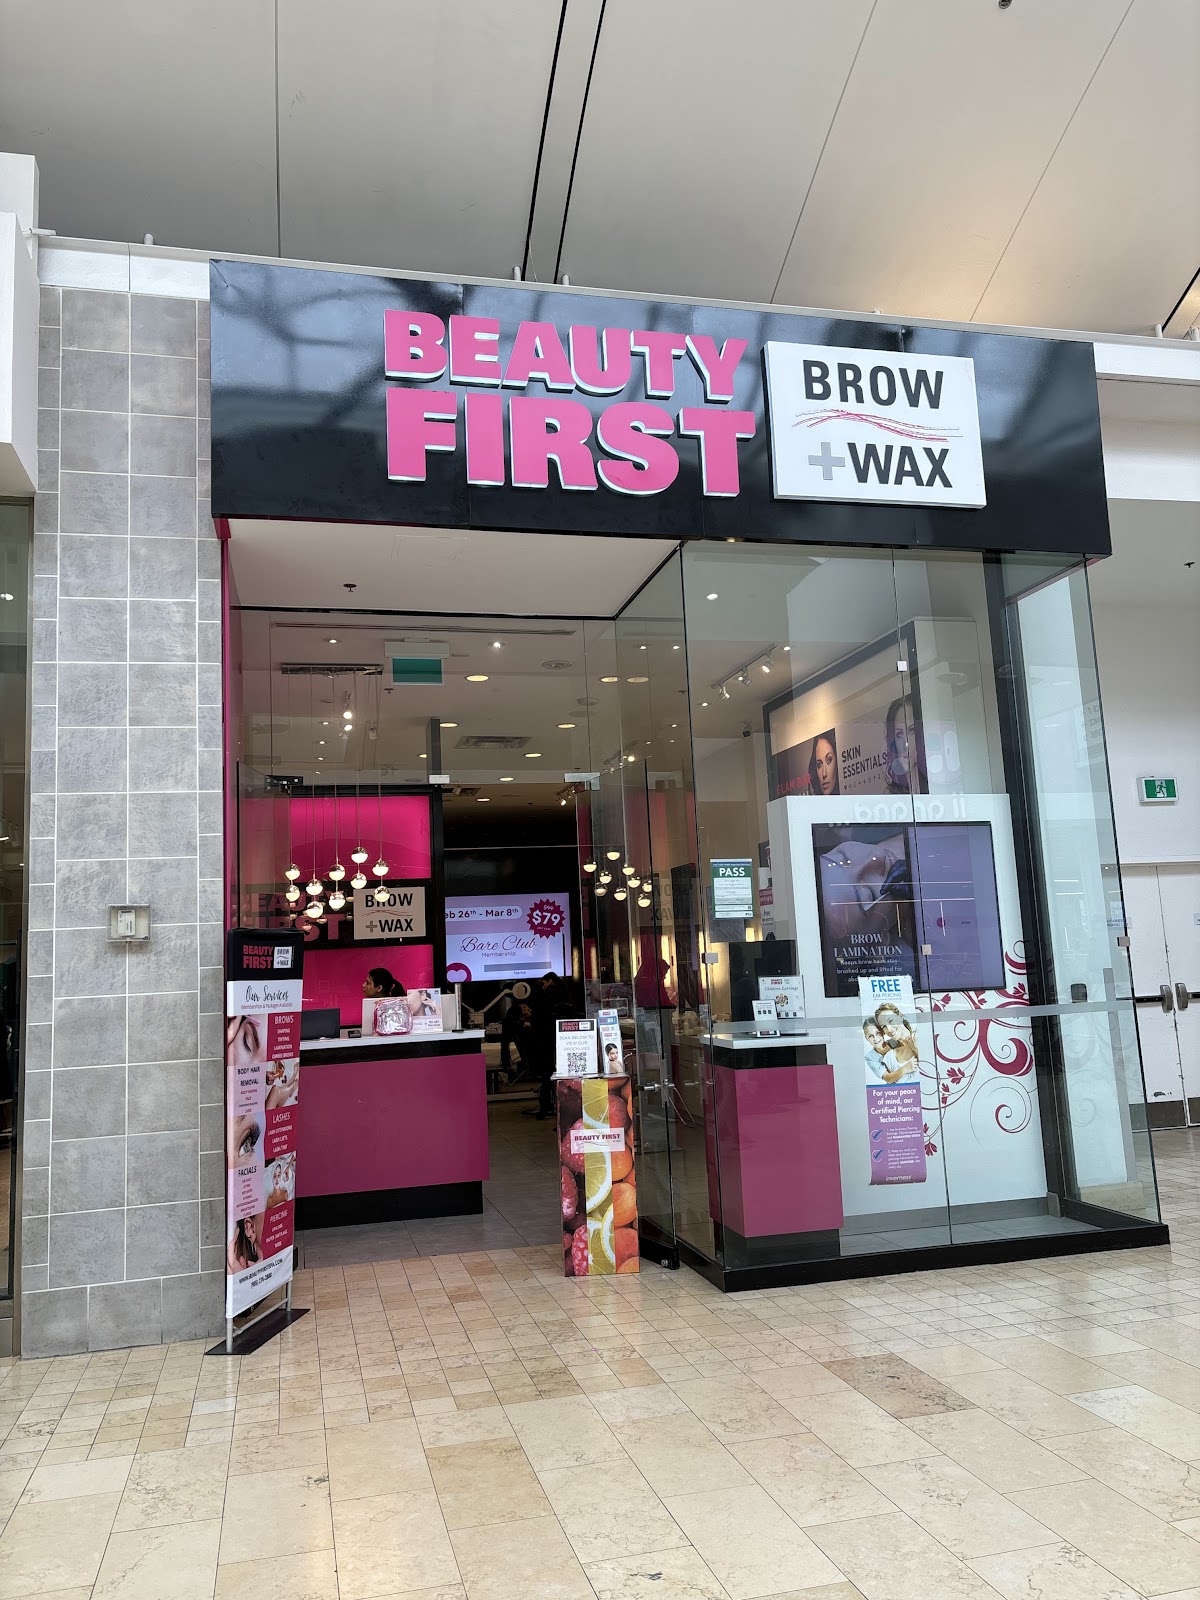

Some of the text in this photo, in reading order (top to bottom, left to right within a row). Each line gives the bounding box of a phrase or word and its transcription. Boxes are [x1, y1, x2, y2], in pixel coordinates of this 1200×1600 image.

[384, 309, 749, 401] BEAUTY
[803, 359, 944, 409] BROW
[386, 387, 756, 497] FIRST
[841, 744, 861, 763] SKIN
[843, 751, 888, 779] ESSENTIALS
[719, 867, 746, 877] PASS
[444, 910, 456, 919] eb
[458, 909, 477, 919] 26th
[485, 909, 504, 918] Mar
[506, 908, 519, 917] 8th
[531, 909, 561, 926] $79
[460, 935, 537, 953] Bare Club
[850, 933, 884, 944] BROW
[243, 944, 273, 956] BEAUTY
[833, 945, 903, 957] LAMINATION
[243, 956, 273, 969] FIRST
[871, 979, 901, 993] FREE
[245, 984, 289, 1003] Our Services
[274, 1015, 294, 1025] BROWS
[240, 1078, 259, 1087] REMOVAL
[872, 1088, 917, 1098] For your peace
[877, 1098, 884, 1106] of
[885, 1097, 902, 1105] mind,
[870, 1105, 920, 1115] Certified Piercing
[272, 1111, 291, 1123] LASHES
[879, 1115, 914, 1124] Technicians:
[574, 1134, 600, 1142] BEAUTY
[238, 1165, 257, 1178] FACIALS
[269, 1209, 288, 1224] PIERCING
